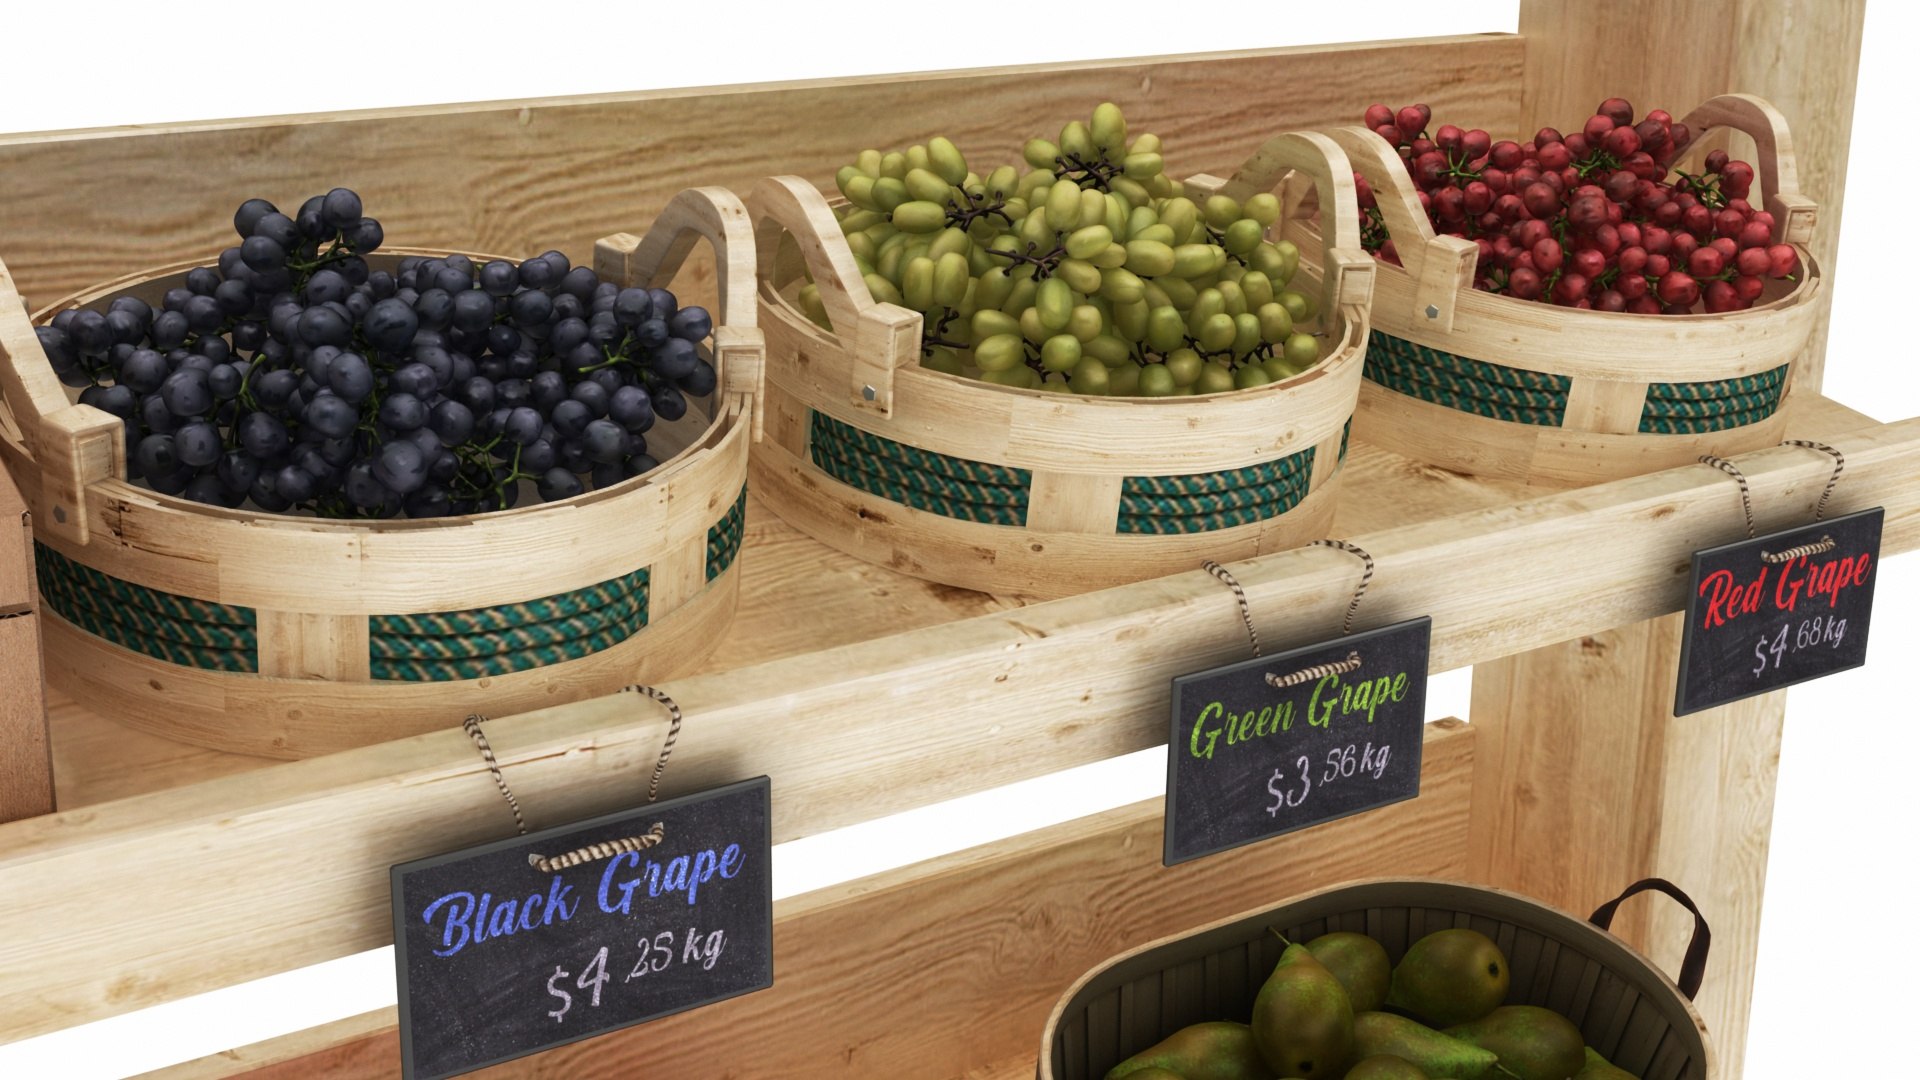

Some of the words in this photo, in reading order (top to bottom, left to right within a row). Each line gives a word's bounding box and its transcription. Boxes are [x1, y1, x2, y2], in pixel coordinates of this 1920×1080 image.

[1699, 565, 1767, 630] Red
[1774, 552, 1872, 614] Grape
[1190, 701, 1296, 759] Green
[1307, 671, 1411, 729] Grape
[422, 875, 581, 957] Black
[596, 842, 747, 915] Grape
